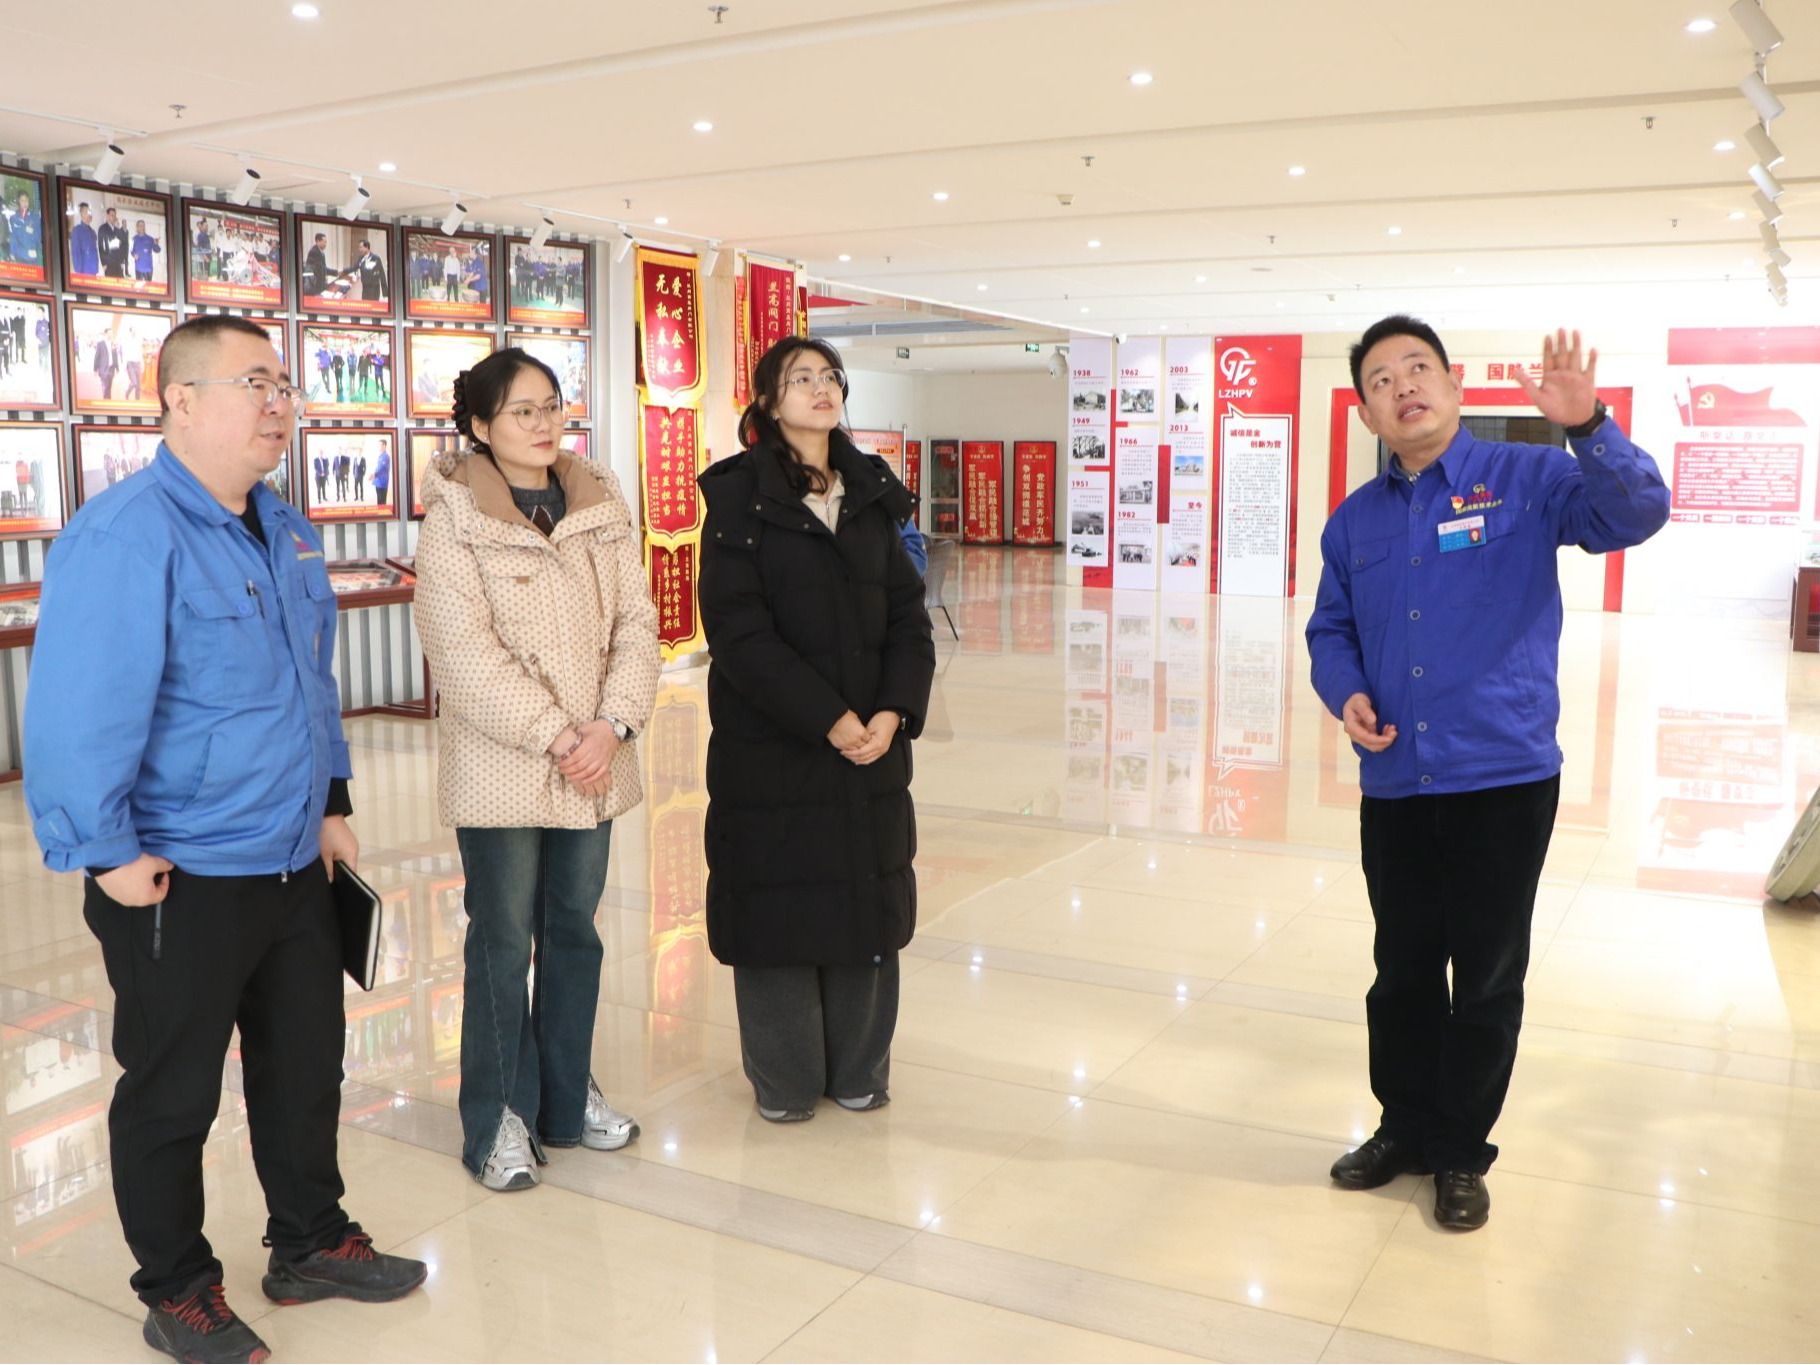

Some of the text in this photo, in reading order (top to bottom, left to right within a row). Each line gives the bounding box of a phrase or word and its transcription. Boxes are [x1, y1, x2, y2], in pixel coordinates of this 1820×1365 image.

[655, 272, 671, 375] 无私奉献
[671, 275, 686, 373] 爱心企业
[1218, 389, 1253, 398] LZHPV
